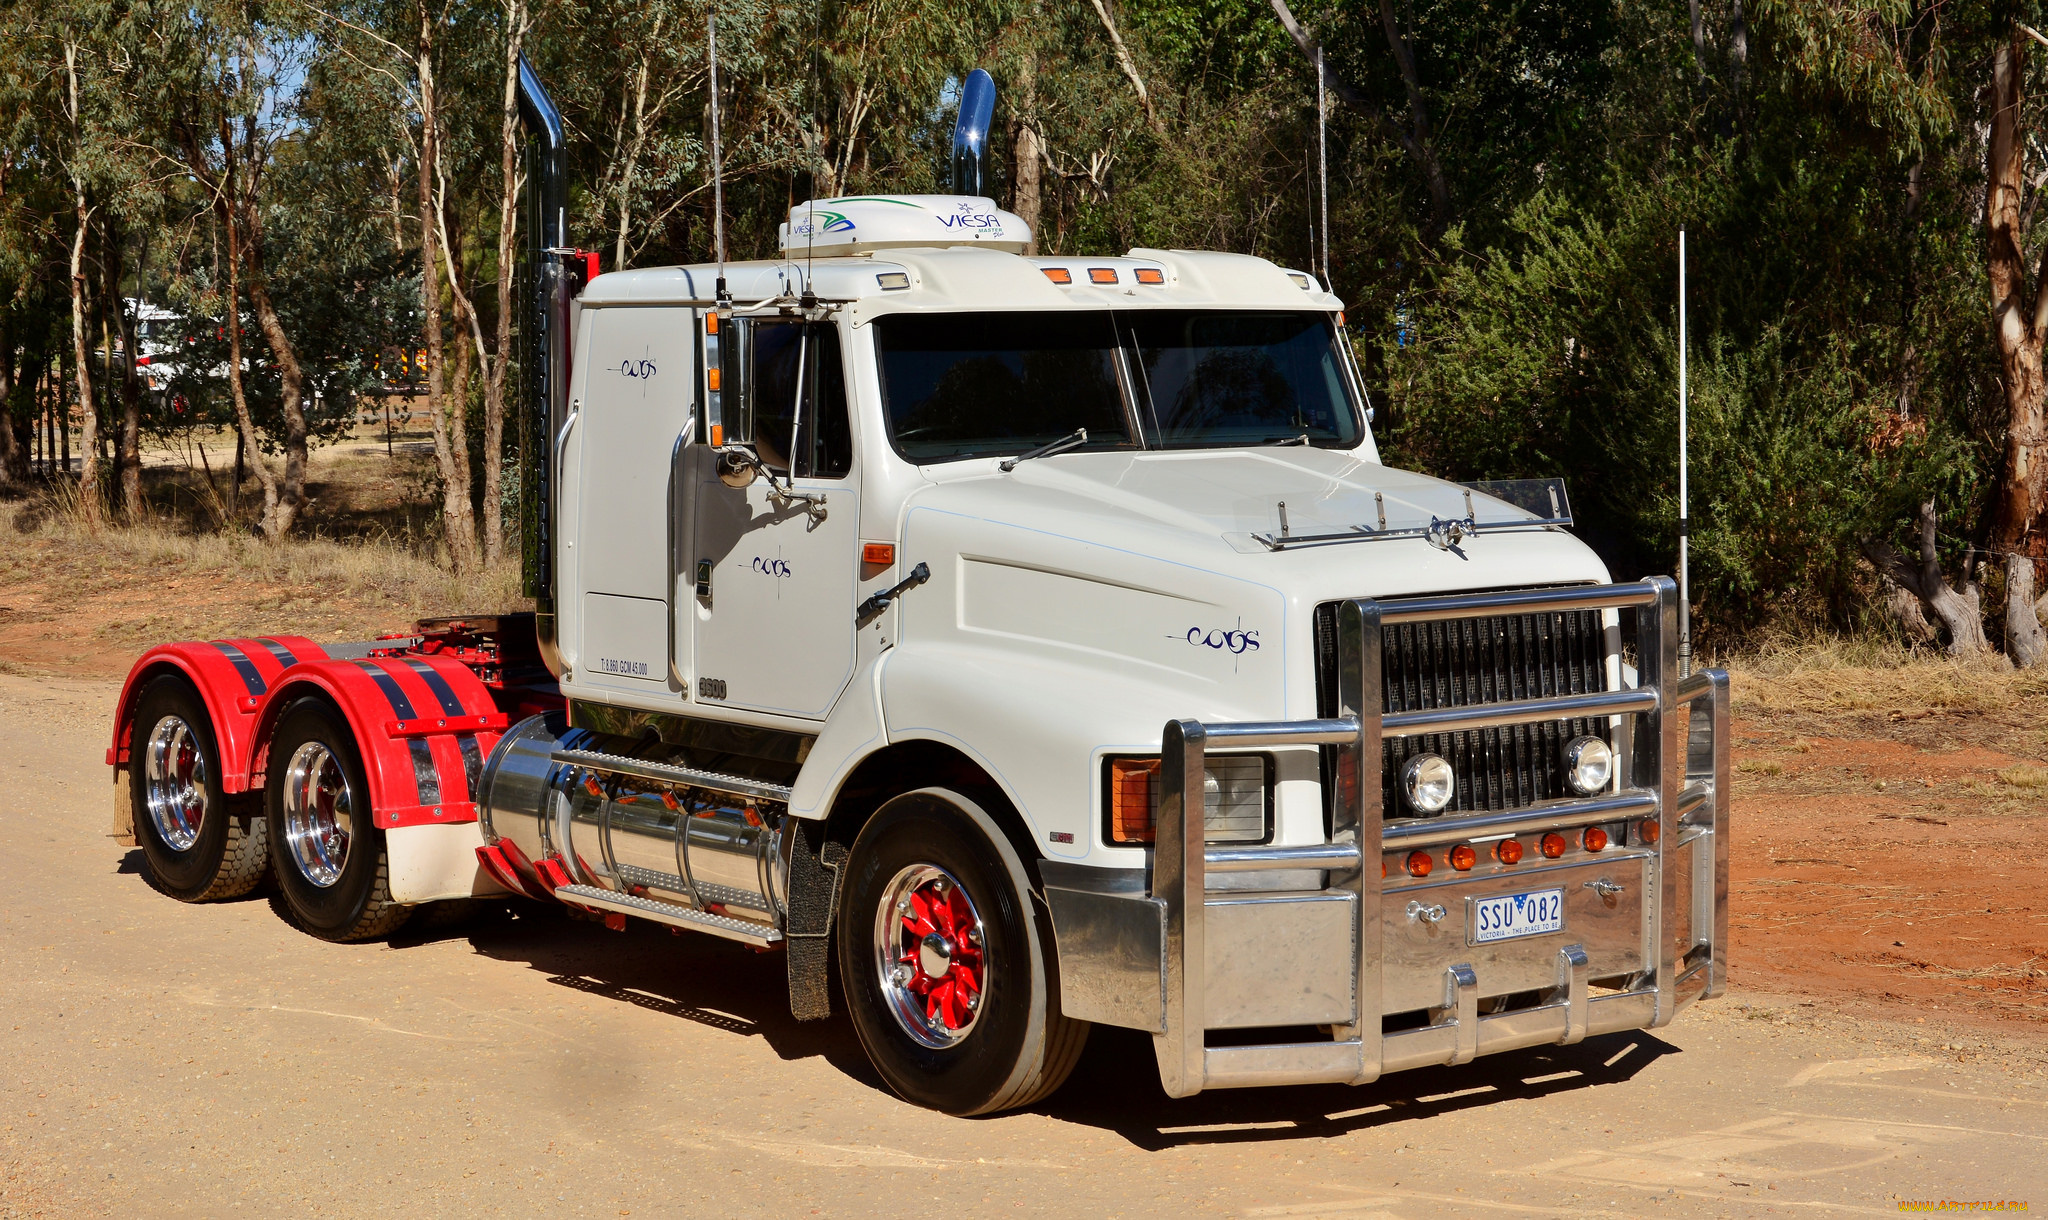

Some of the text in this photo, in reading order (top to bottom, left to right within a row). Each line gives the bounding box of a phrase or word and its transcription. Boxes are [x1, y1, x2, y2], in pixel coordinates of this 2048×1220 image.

[936, 214, 1001, 228] VIESA
[699, 677, 728, 700] 3600
[1480, 895, 1559, 931] SSU 082
[1480, 931, 1505, 939] VICTORIA
